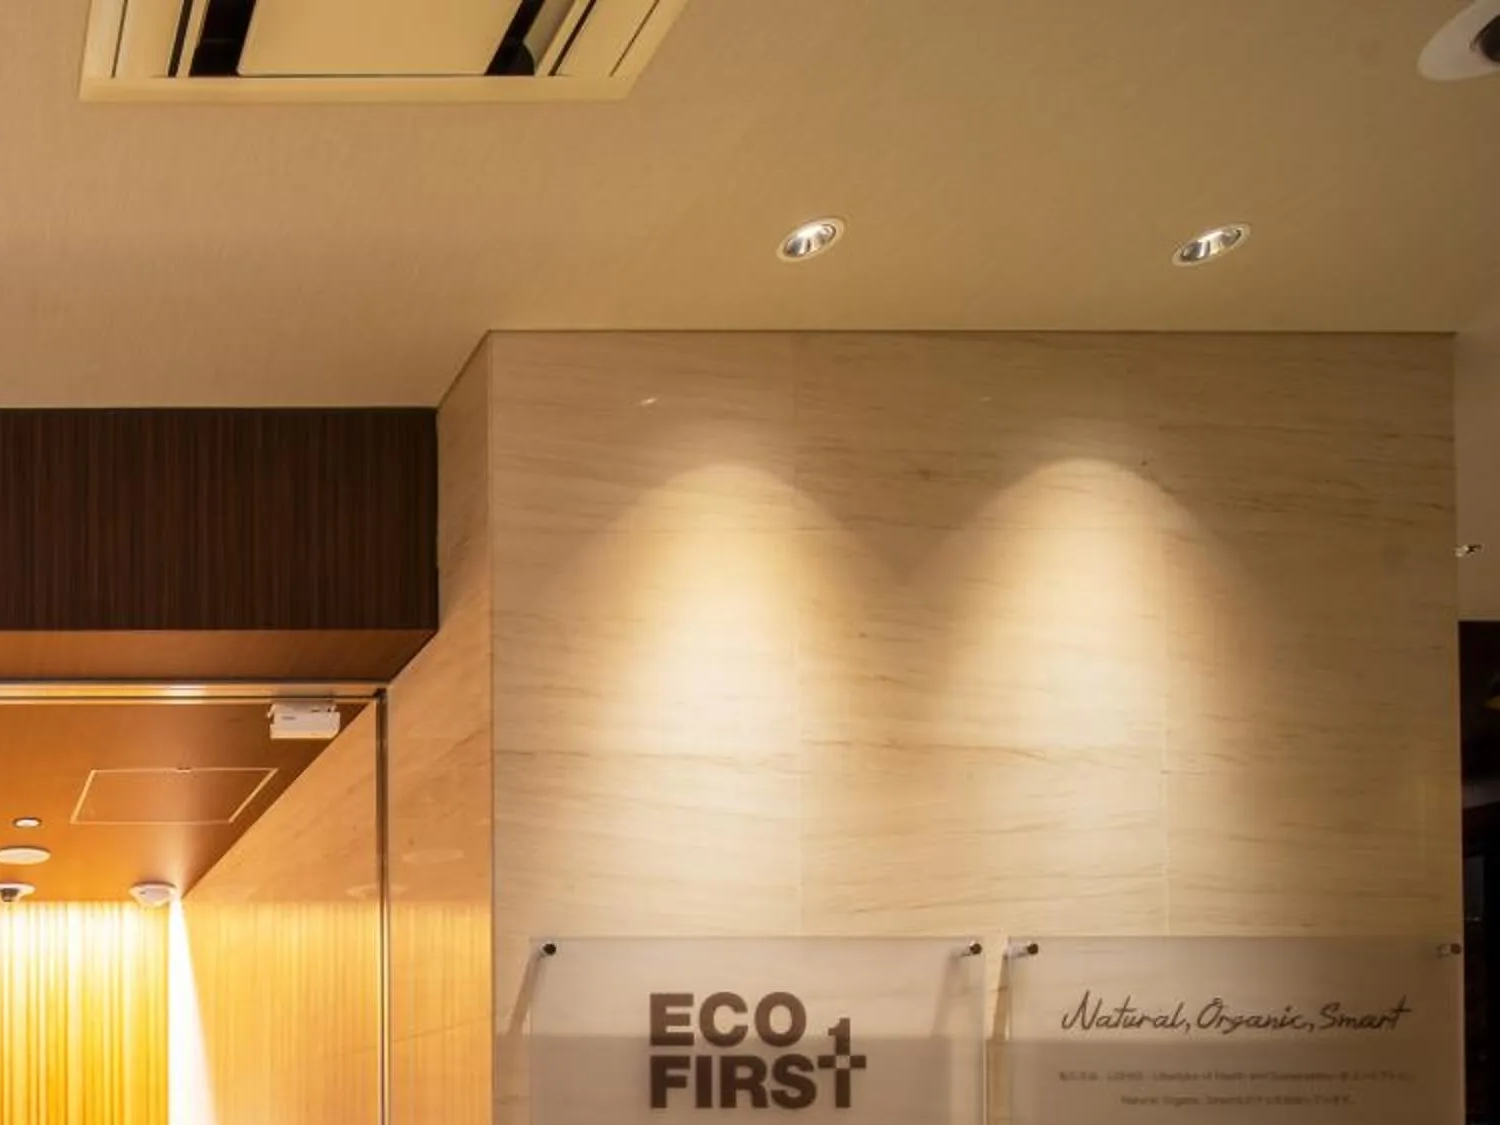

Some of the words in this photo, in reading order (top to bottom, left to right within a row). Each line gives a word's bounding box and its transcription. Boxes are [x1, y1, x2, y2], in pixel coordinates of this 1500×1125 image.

[649, 991, 807, 1048] ECO
[1061, 989, 1191, 1033] Natural,
[1197, 997, 1314, 1034] Organic,
[1319, 995, 1412, 1030] Smart
